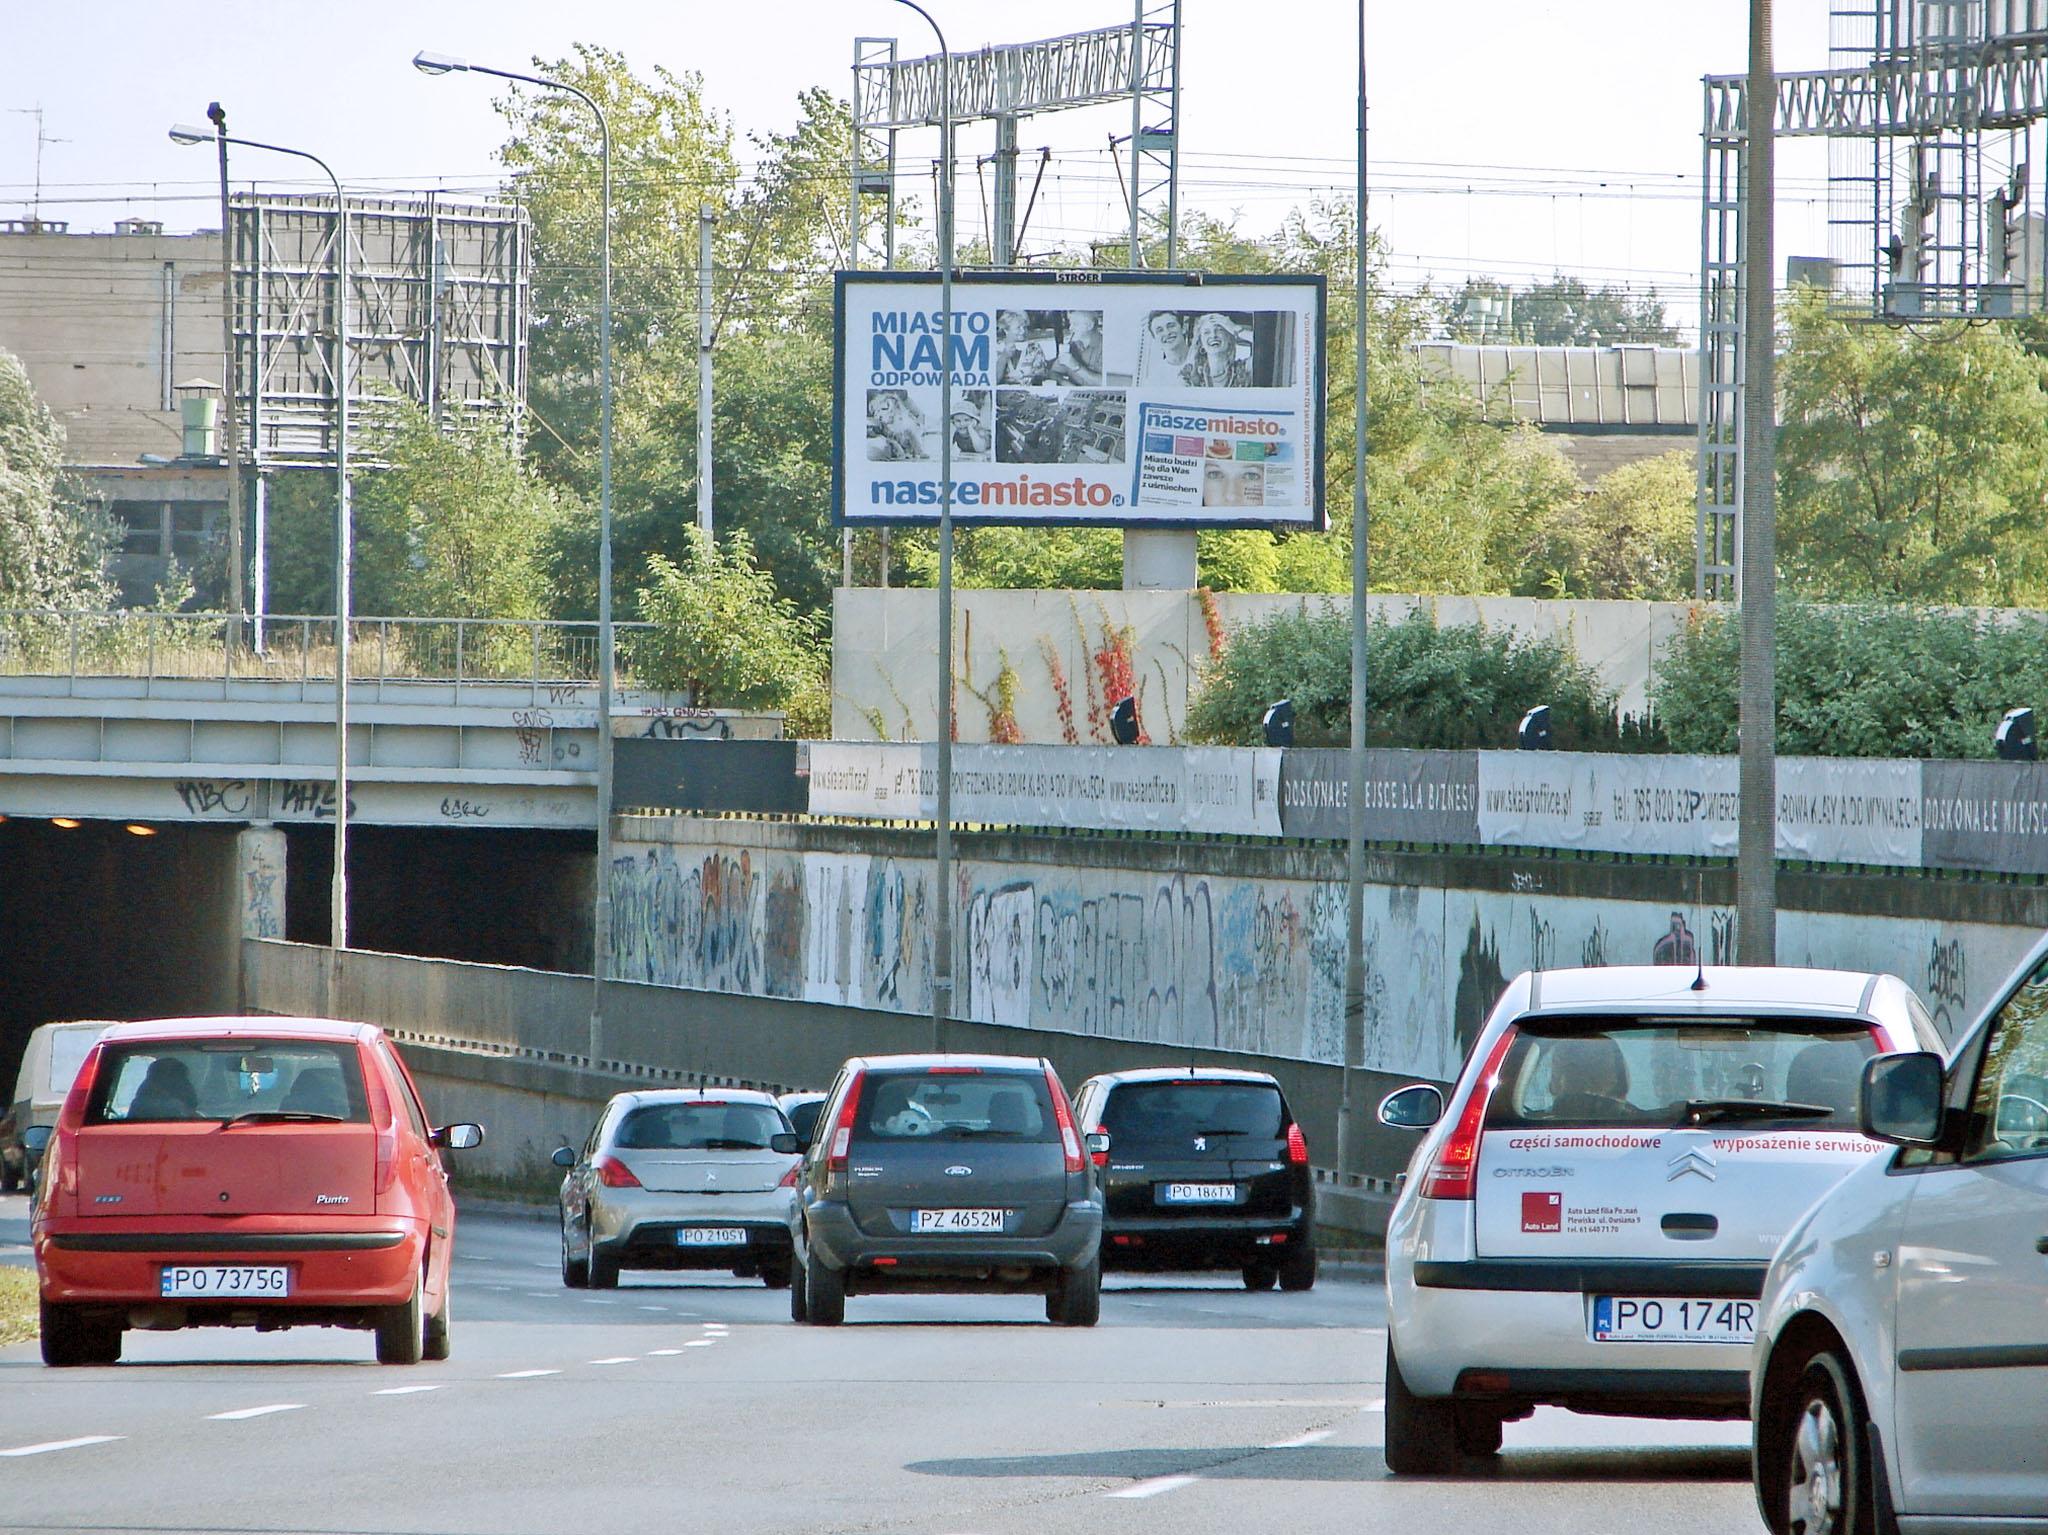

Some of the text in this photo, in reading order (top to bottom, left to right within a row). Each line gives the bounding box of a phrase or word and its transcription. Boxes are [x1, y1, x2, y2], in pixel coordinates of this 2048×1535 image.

[872, 312, 990, 334] MIASTO
[872, 334, 990, 371] NAM
[871, 372, 991, 386] ODPOWADA
[1147, 414, 1279, 435] naszemiasto
[1145, 455, 1197, 467] Miasto budzi
[1172, 466, 1190, 474] Was
[1284, 780, 1349, 808] DOSKONAŁE
[1365, 781, 1398, 809] EJSCE
[1403, 782, 1423, 811] DLA
[1428, 783, 1476, 812] BIZNESU
[1655, 788, 1674, 822] 020
[1677, 788, 1690, 822] 52
[1840, 795, 1848, 825] A
[1924, 798, 2048, 834] DOSKONAŁE MIEJSC
[1509, 1135, 1662, 1152] części samochodowe
[1713, 1136, 1885, 1153] wyposażenie serwisów
[316, 1194, 349, 1204] Punto
[1172, 1185, 1233, 1197] PO 186TX
[921, 1211, 1001, 1227] PZ 4652M
[1567, 1207, 1582, 1215] Auto
[1583, 1207, 1599, 1215] Land
[1600, 1207, 1613, 1215] filia
[1524, 1222, 1559, 1231] Auto Land
[684, 1229, 703, 1242] PO
[176, 1269, 283, 1290] PO 7375G
[1599, 1319, 1610, 1328] PL
[1618, 1301, 1758, 1332] PO 174R
